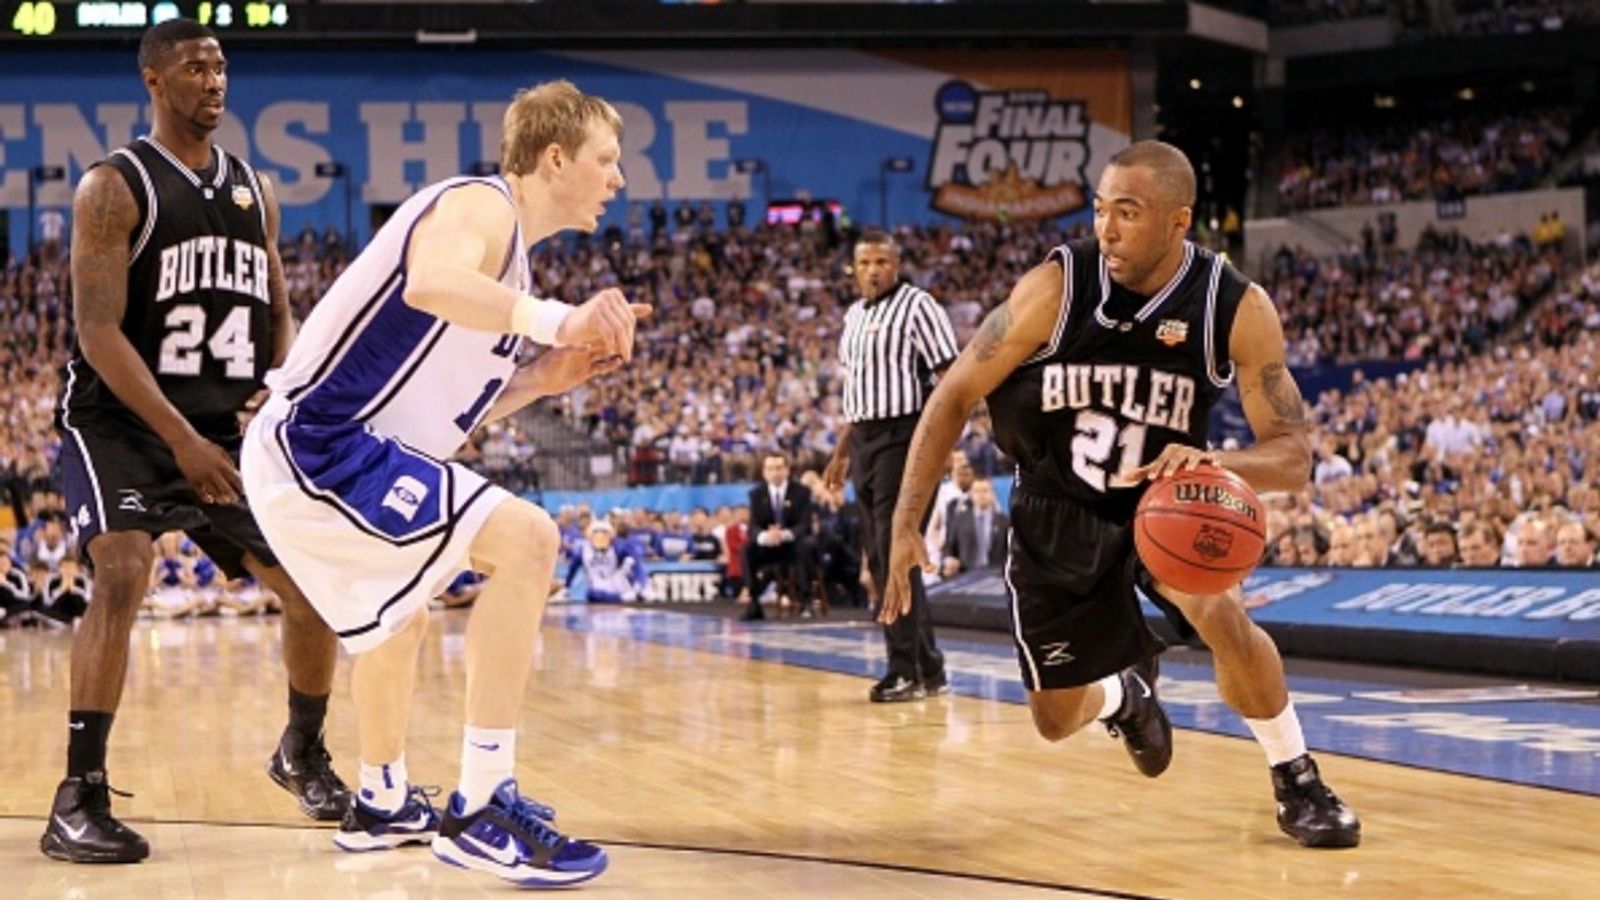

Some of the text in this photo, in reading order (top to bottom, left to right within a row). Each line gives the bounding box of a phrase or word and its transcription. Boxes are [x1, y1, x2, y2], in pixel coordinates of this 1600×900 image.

[13, 2, 55, 35] 40
[974, 94, 1086, 138] FINAL
[929, 124, 1087, 187] FOUR
[156, 235, 271, 304] BUTLER
[157, 303, 256, 380] 24
[1041, 362, 1196, 434] BUTLER
[1070, 409, 1148, 493] 21
[1174, 482, 1258, 522] Wilson
